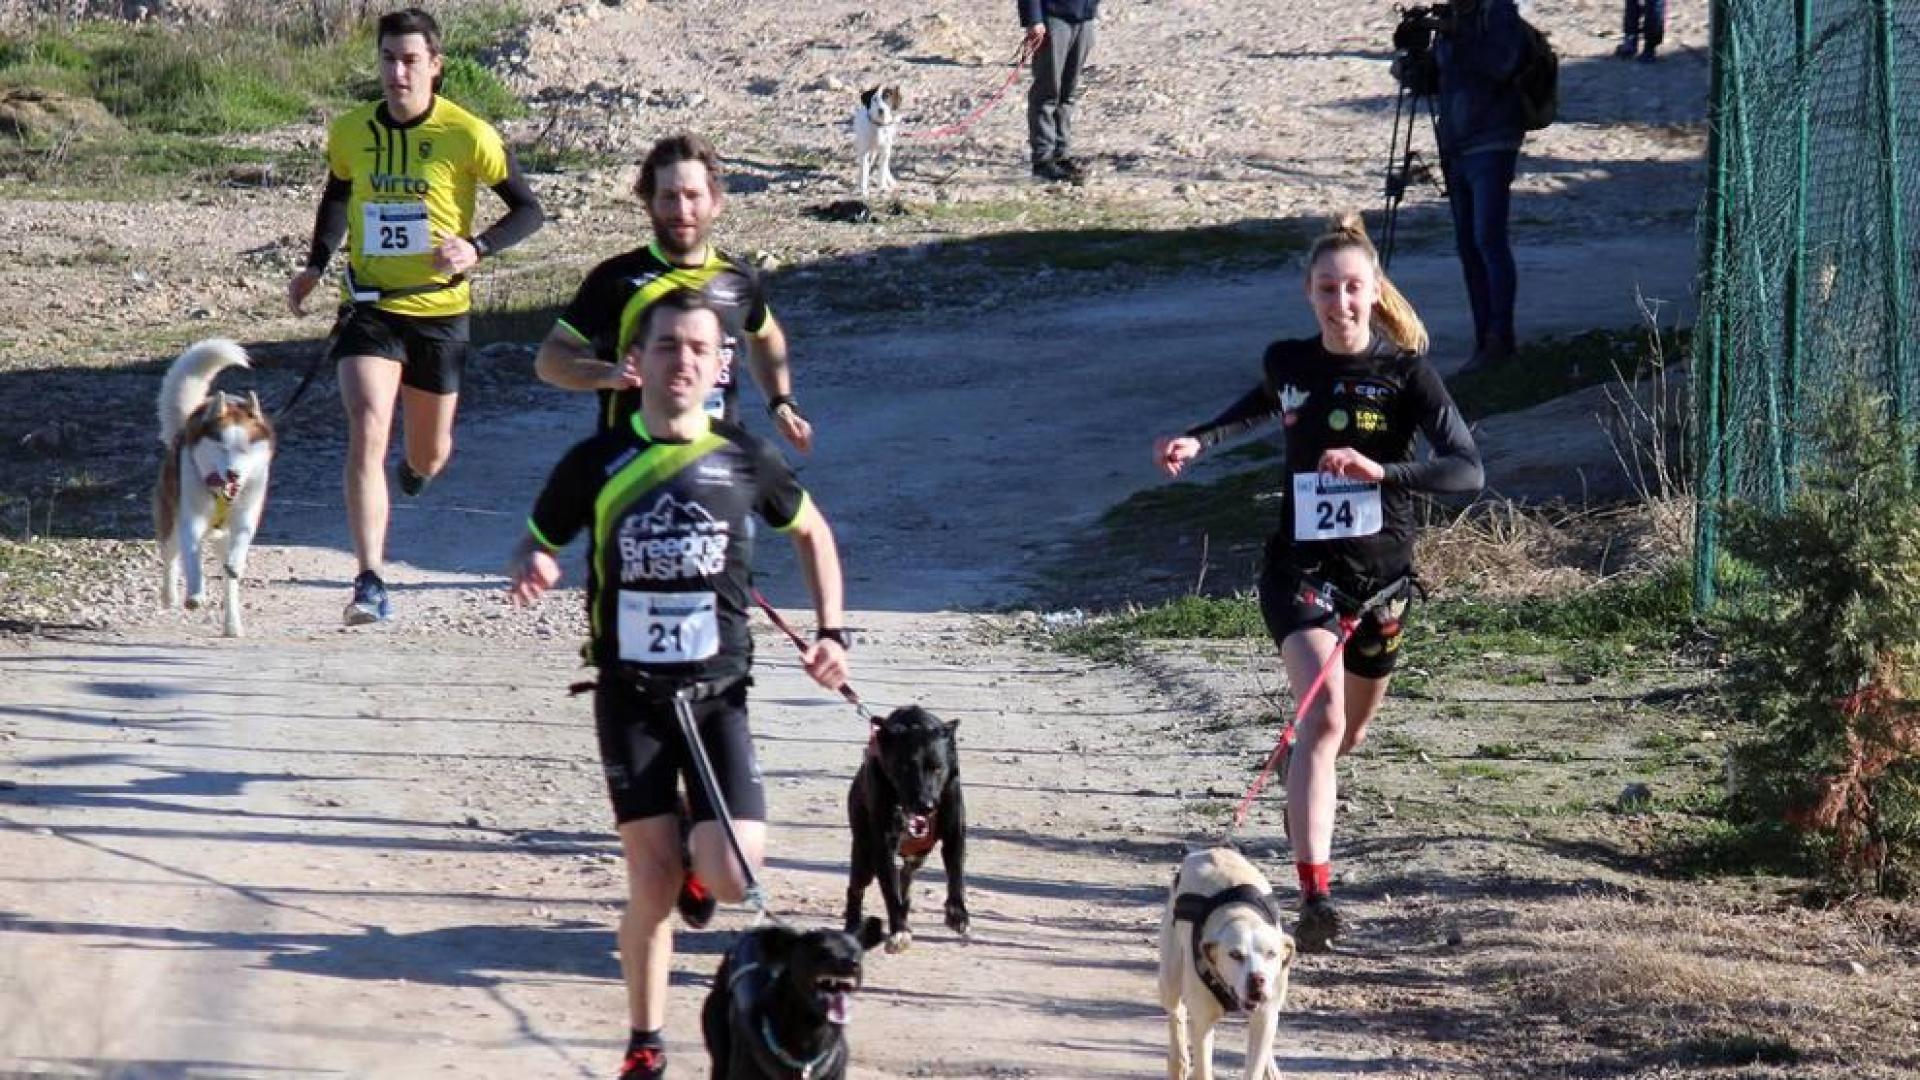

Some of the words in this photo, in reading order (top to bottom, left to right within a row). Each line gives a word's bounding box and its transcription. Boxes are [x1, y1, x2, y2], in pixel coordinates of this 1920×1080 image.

[380, 227, 409, 249] 25
[1316, 501, 1354, 529] 24
[648, 624, 683, 652] 21
